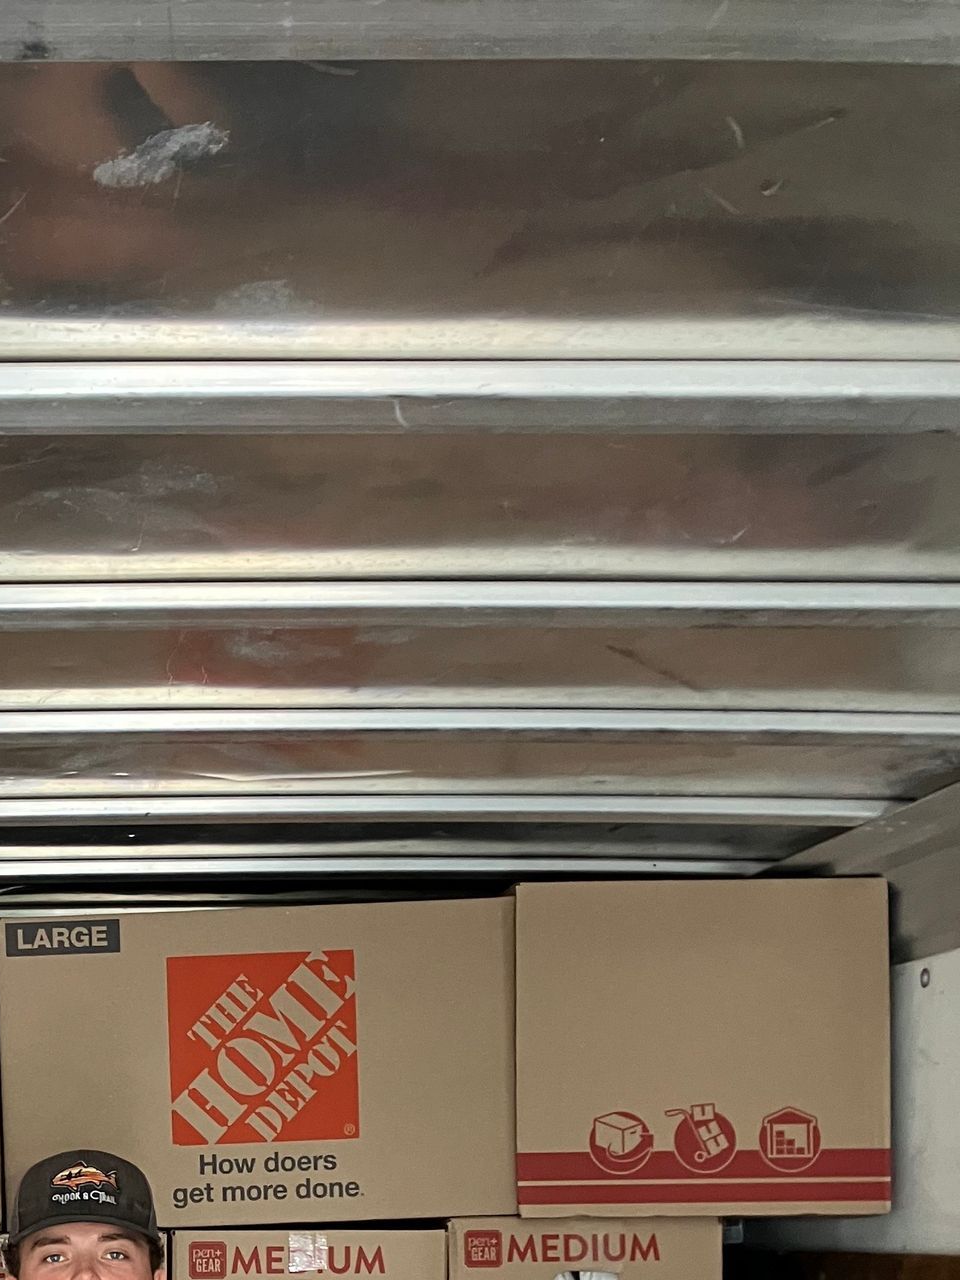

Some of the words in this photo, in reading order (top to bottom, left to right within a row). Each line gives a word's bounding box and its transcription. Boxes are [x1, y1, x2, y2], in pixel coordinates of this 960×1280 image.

[16, 926, 108, 950] LARGE
[186, 973, 265, 1052] THE
[171, 950, 356, 1146] HOME
[244, 1020, 358, 1143] DEPOT
[198, 1154, 258, 1175] How
[263, 1151, 338, 1173] doers
[172, 1182, 214, 1208] get
[221, 1181, 288, 1203] more
[191, 1248, 223, 1266] pen+
[231, 1244, 387, 1275] MEUM
[470, 1246, 499, 1262] GEAR
[507, 1232, 662, 1263] MEDIUM
[195, 1258, 222, 1273] GEAR
